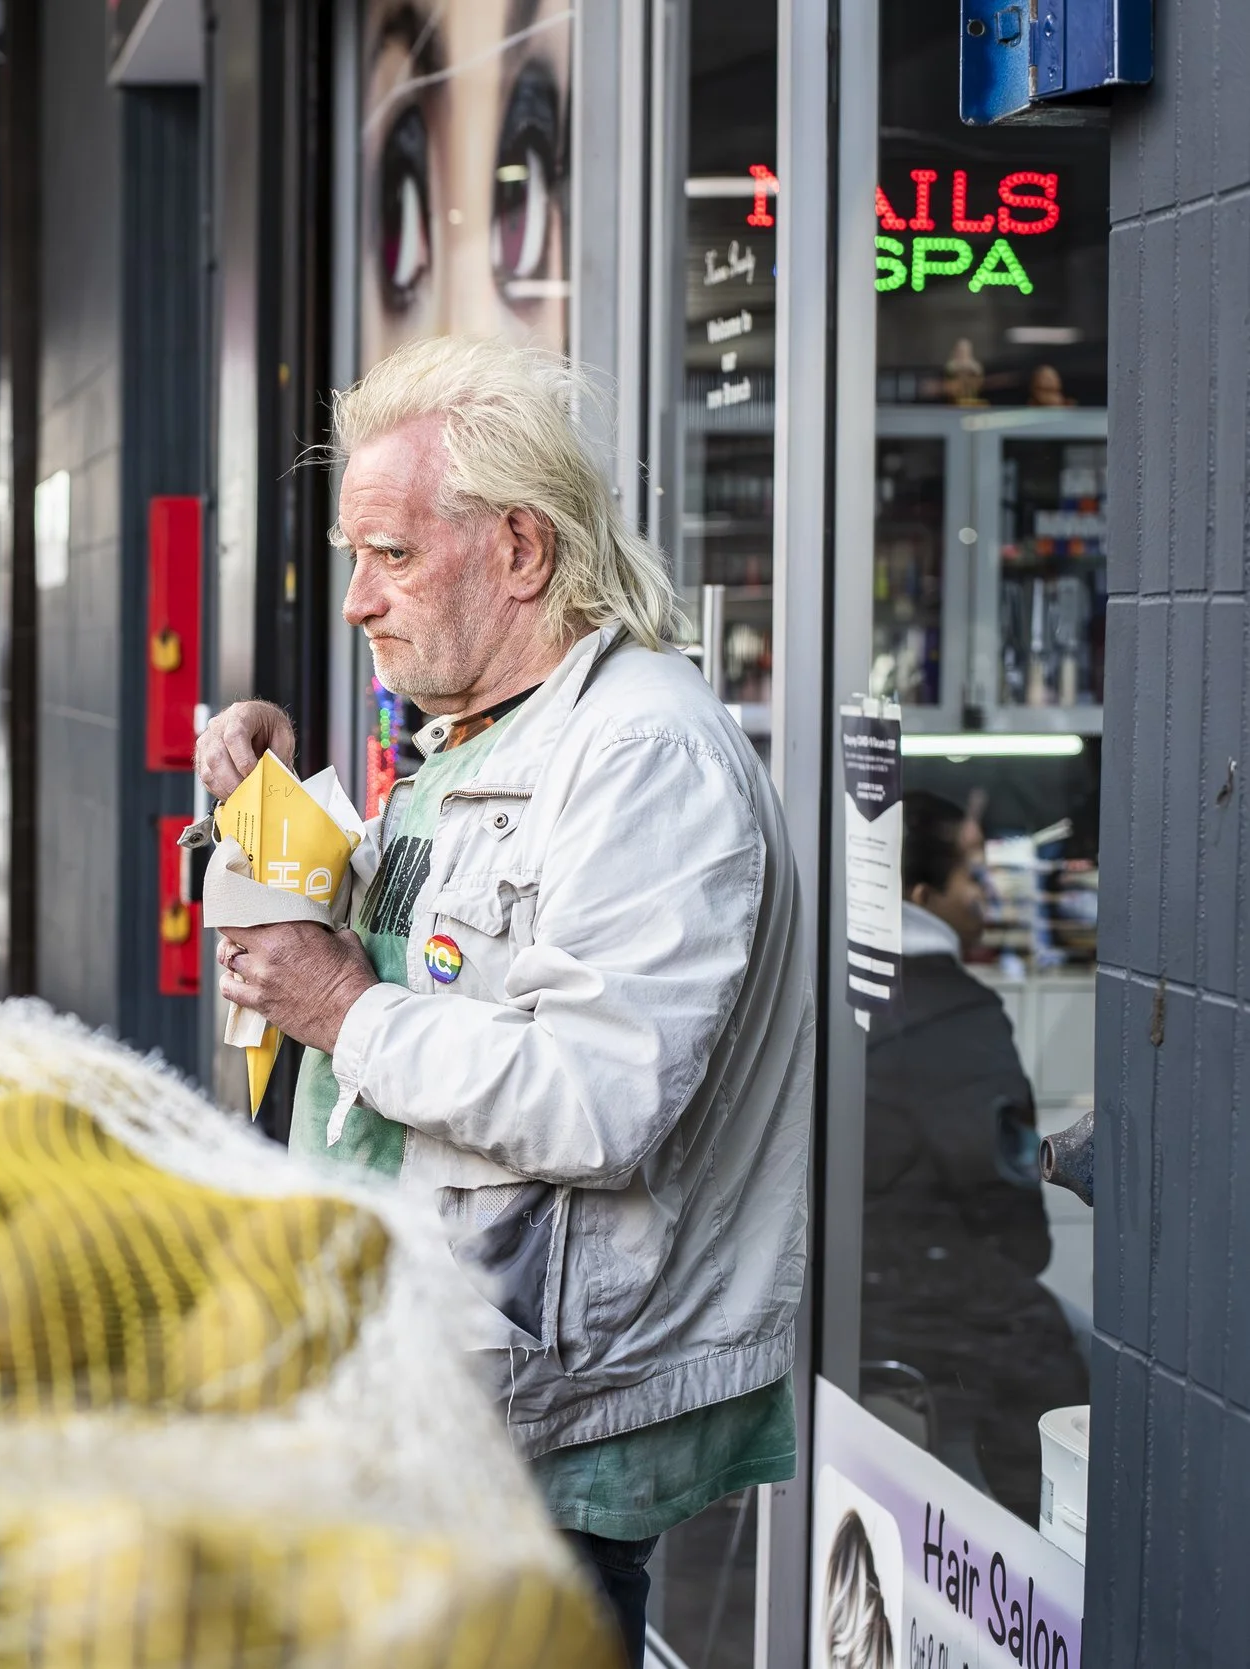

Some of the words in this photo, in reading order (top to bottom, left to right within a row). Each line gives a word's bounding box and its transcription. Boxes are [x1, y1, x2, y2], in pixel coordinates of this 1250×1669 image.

[874, 235, 1034, 294] SPA
[923, 1501, 980, 1619] Hair
[987, 1551, 1069, 1669] Salon
